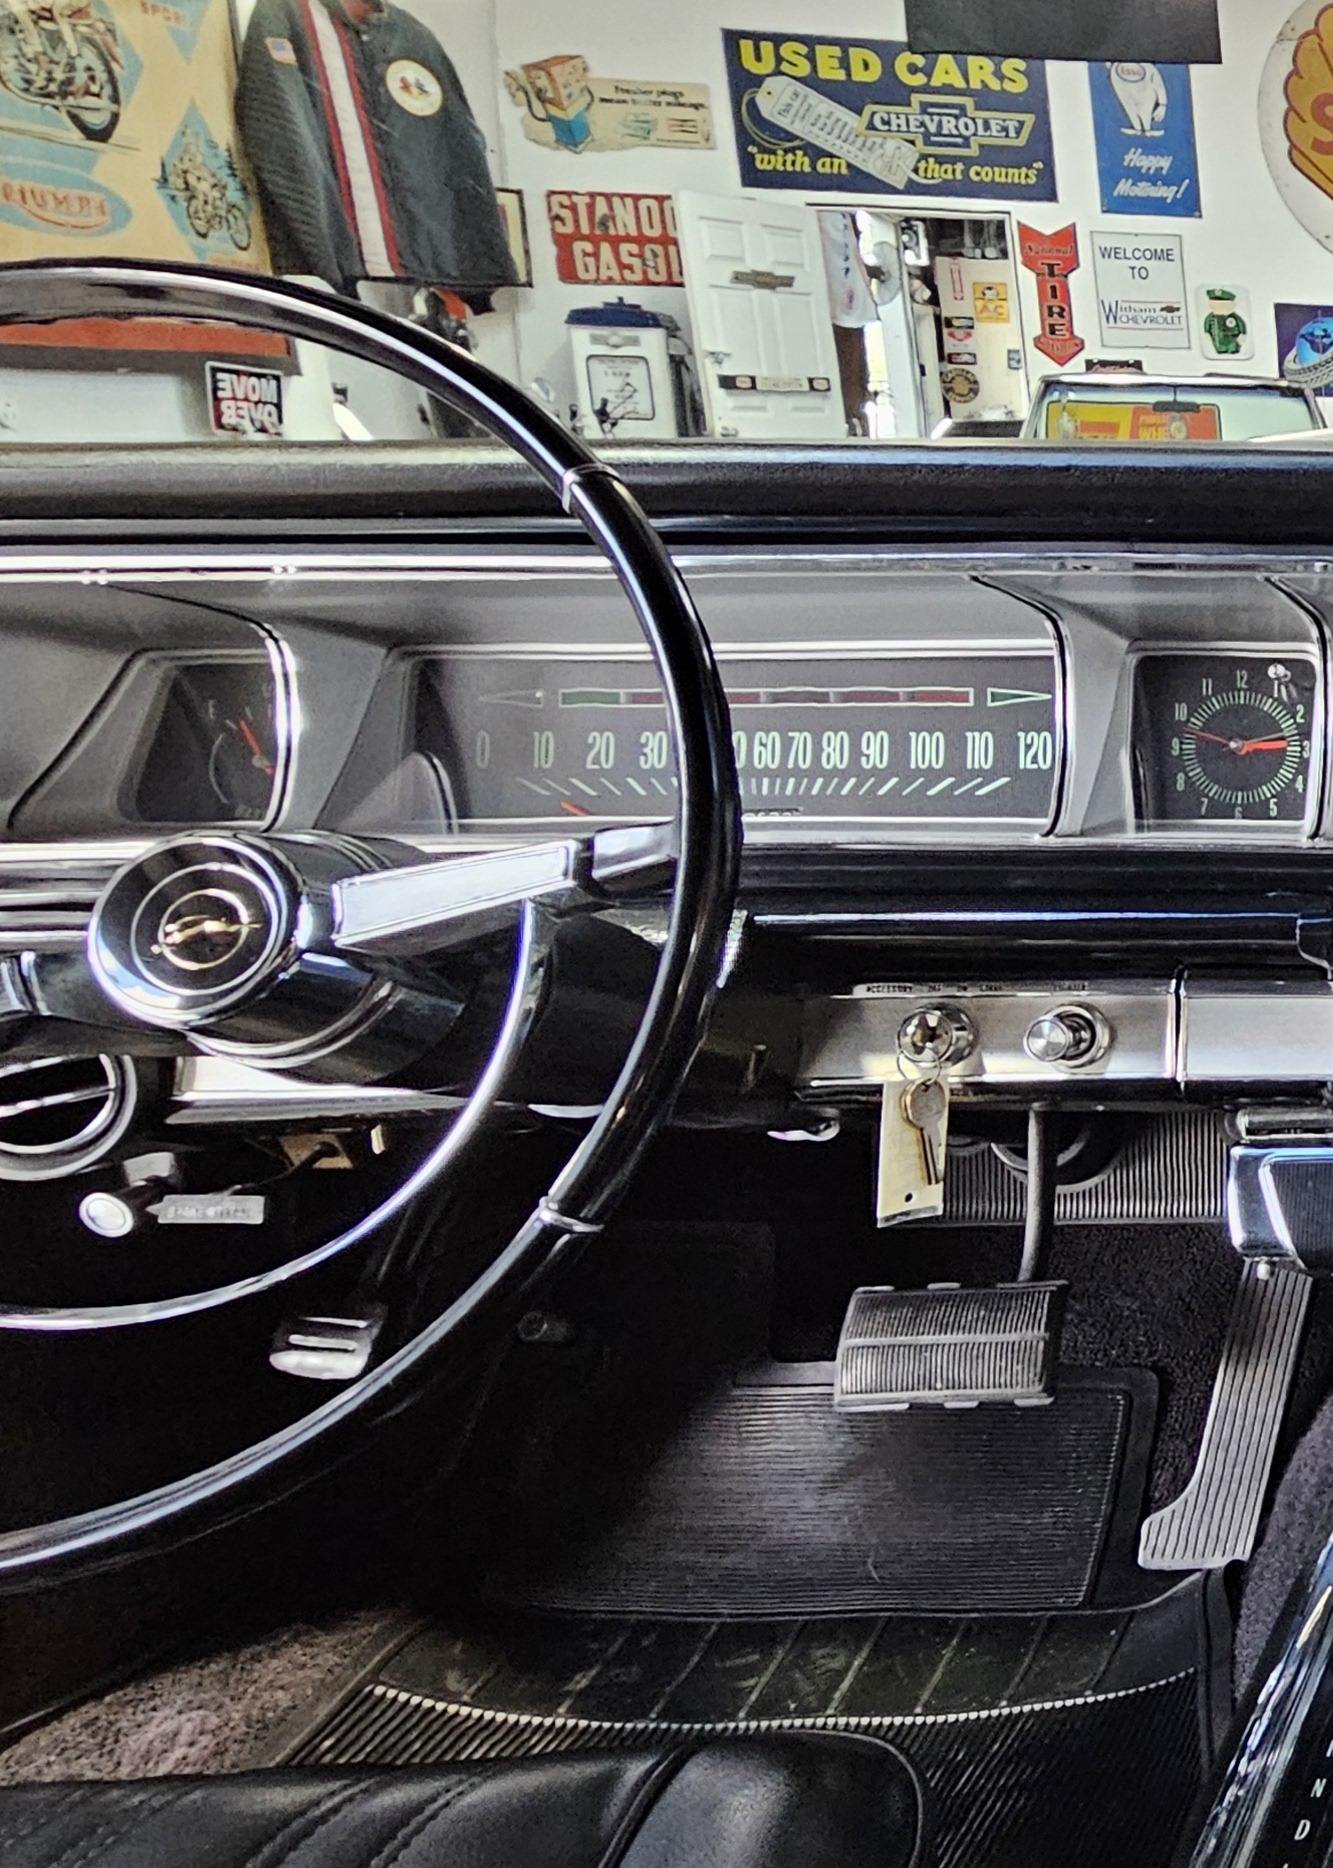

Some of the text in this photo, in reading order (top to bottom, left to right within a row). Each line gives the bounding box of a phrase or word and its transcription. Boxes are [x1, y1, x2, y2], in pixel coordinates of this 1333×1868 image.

[739, 38, 1030, 94] USED CARS
[873, 111, 1020, 138] CHEVROLET
[816, 157, 848, 175] an
[917, 158, 964, 182] that
[1123, 147, 1174, 175] Happy
[1099, 246, 1175, 262] WELCOME
[1129, 266, 1149, 280] TO
[1040, 261, 1067, 337] TIRE
[1119, 315, 1182, 326] CHEVROLET
[1202, 678, 1212, 696] 11
[1236, 669, 1248, 689] 12
[1174, 703, 1188, 722] 10
[1296, 704, 1305, 723] 2
[476, 731, 490, 768] 0
[533, 731, 554, 768] 10
[586, 732, 615, 769] 20
[639, 731, 667, 768] 30
[753, 731, 781, 769] 60
[787, 731, 812, 769] 70
[821, 731, 849, 770] 80
[861, 731, 889, 769] 90
[909, 731, 945, 770] 100
[965, 731, 994, 770] 110
[1017, 731, 1052, 769] 120
[1171, 737, 1180, 756] 9
[1302, 740, 1310, 758] 3
[1176, 772, 1185, 791] 8
[1295, 774, 1304, 793] 4
[1201, 798, 1209, 815] 7
[1269, 799, 1278, 817] 5
[1310, 1778, 1327, 1798] N
[1294, 1819, 1312, 1841] D
